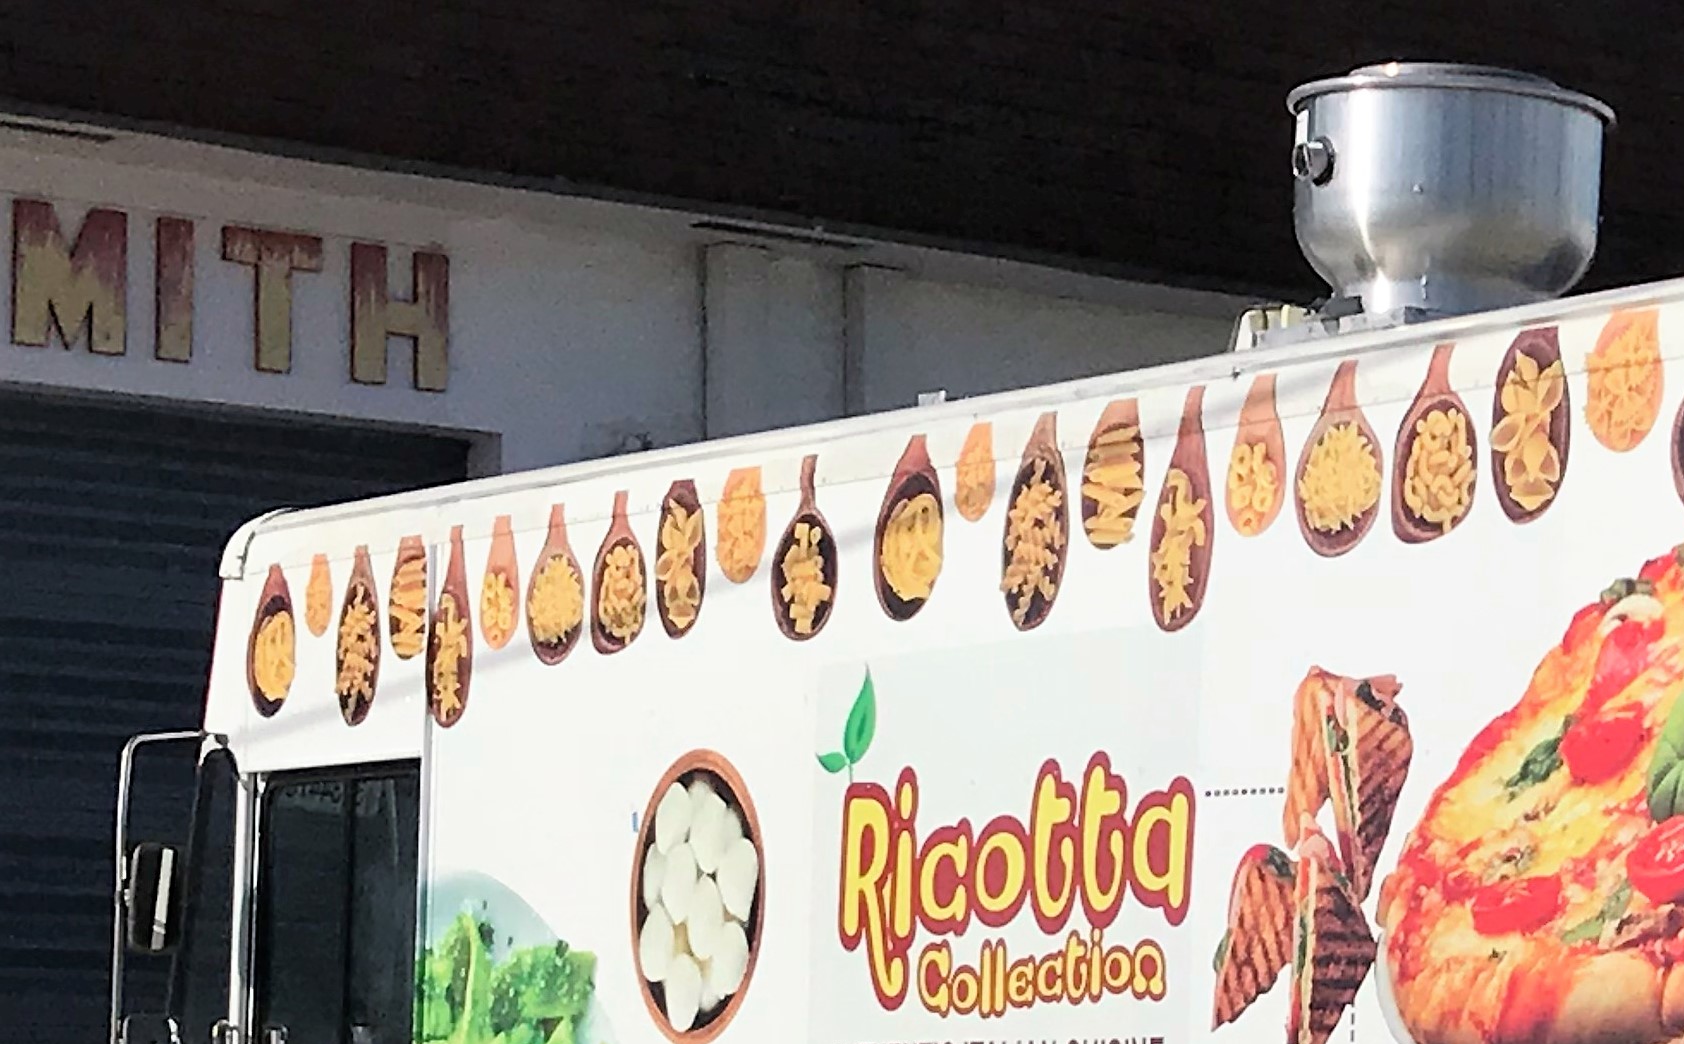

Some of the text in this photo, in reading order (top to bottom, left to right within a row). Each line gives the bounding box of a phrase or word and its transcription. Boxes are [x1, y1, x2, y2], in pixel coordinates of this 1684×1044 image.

[11, 199, 450, 392] MITH
[838, 750, 1196, 1011] Ricotta
[916, 928, 1167, 1020] Collection
